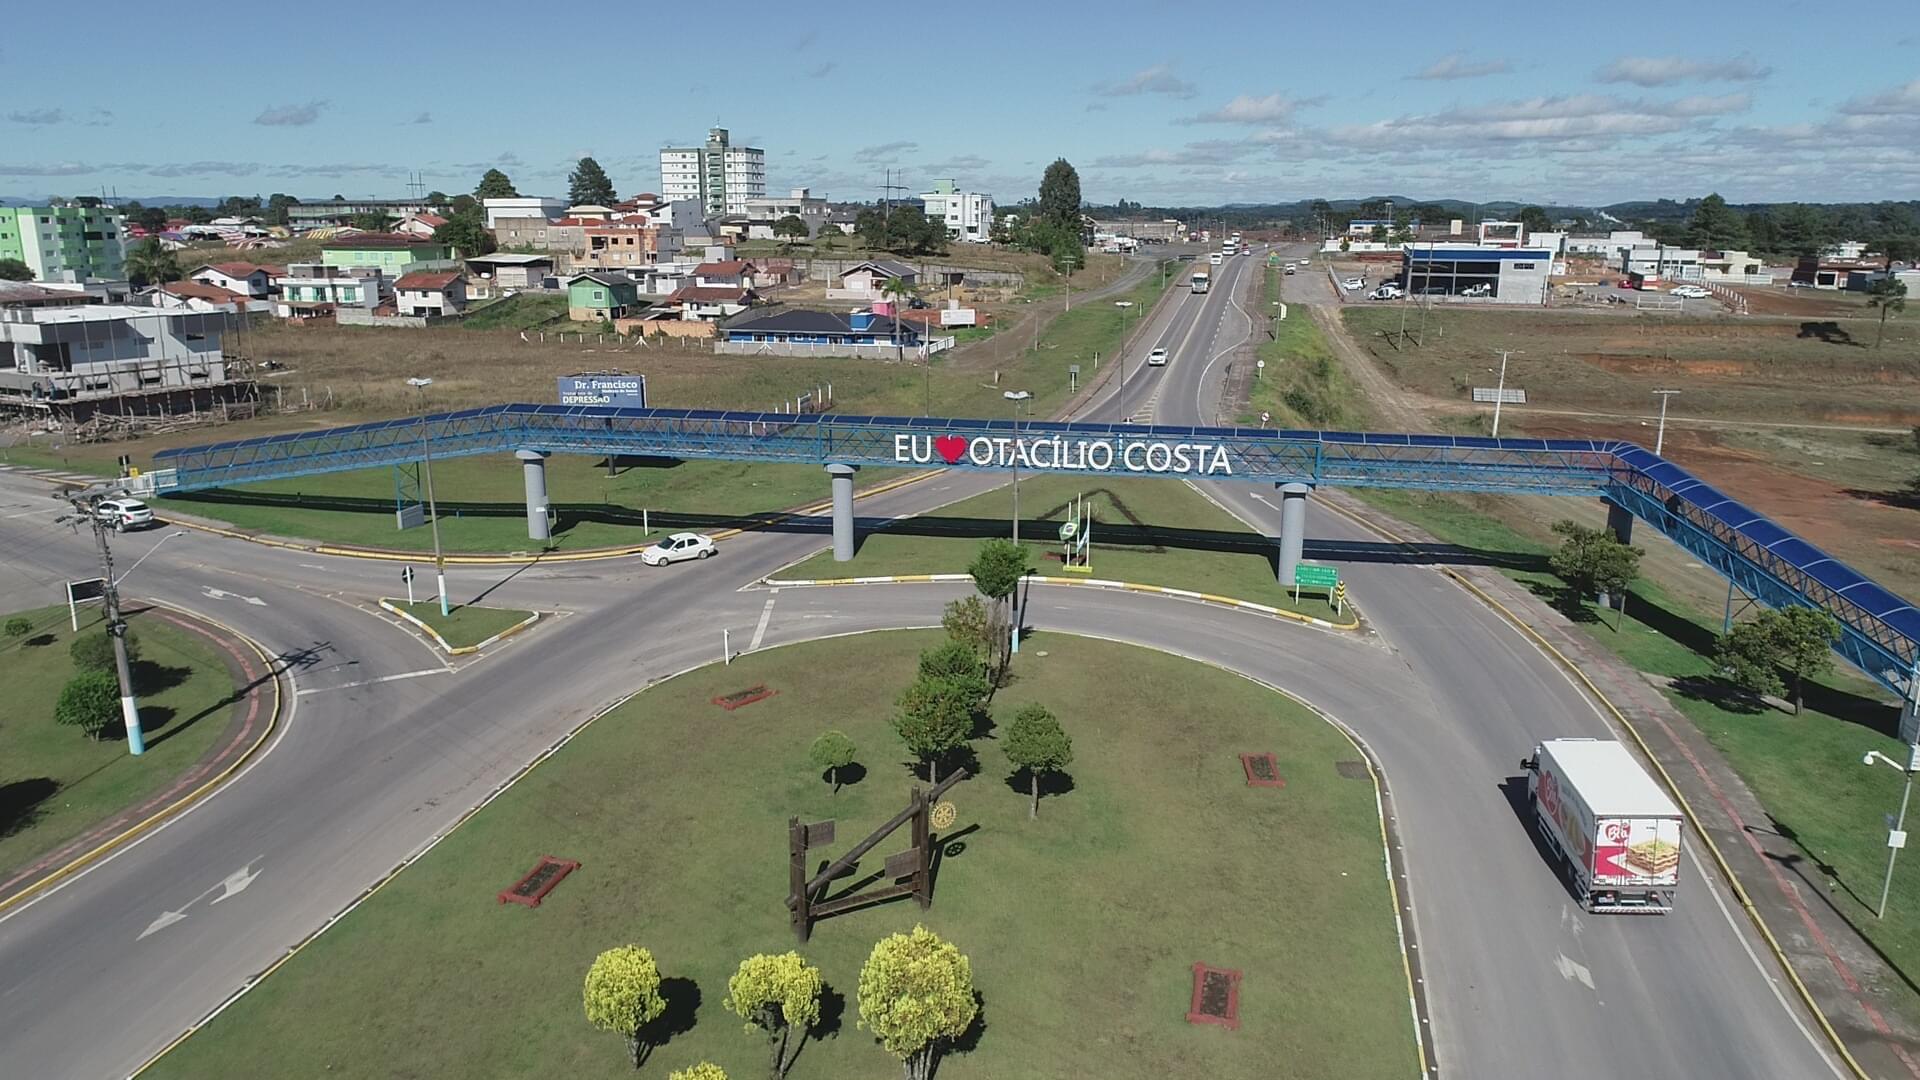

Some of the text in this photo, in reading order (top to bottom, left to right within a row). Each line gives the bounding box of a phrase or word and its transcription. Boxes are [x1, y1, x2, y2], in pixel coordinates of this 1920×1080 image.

[574, 379, 638, 389] Dr. Francisco
[894, 434, 1232, 476] EU OTACÍLIO COSTA
